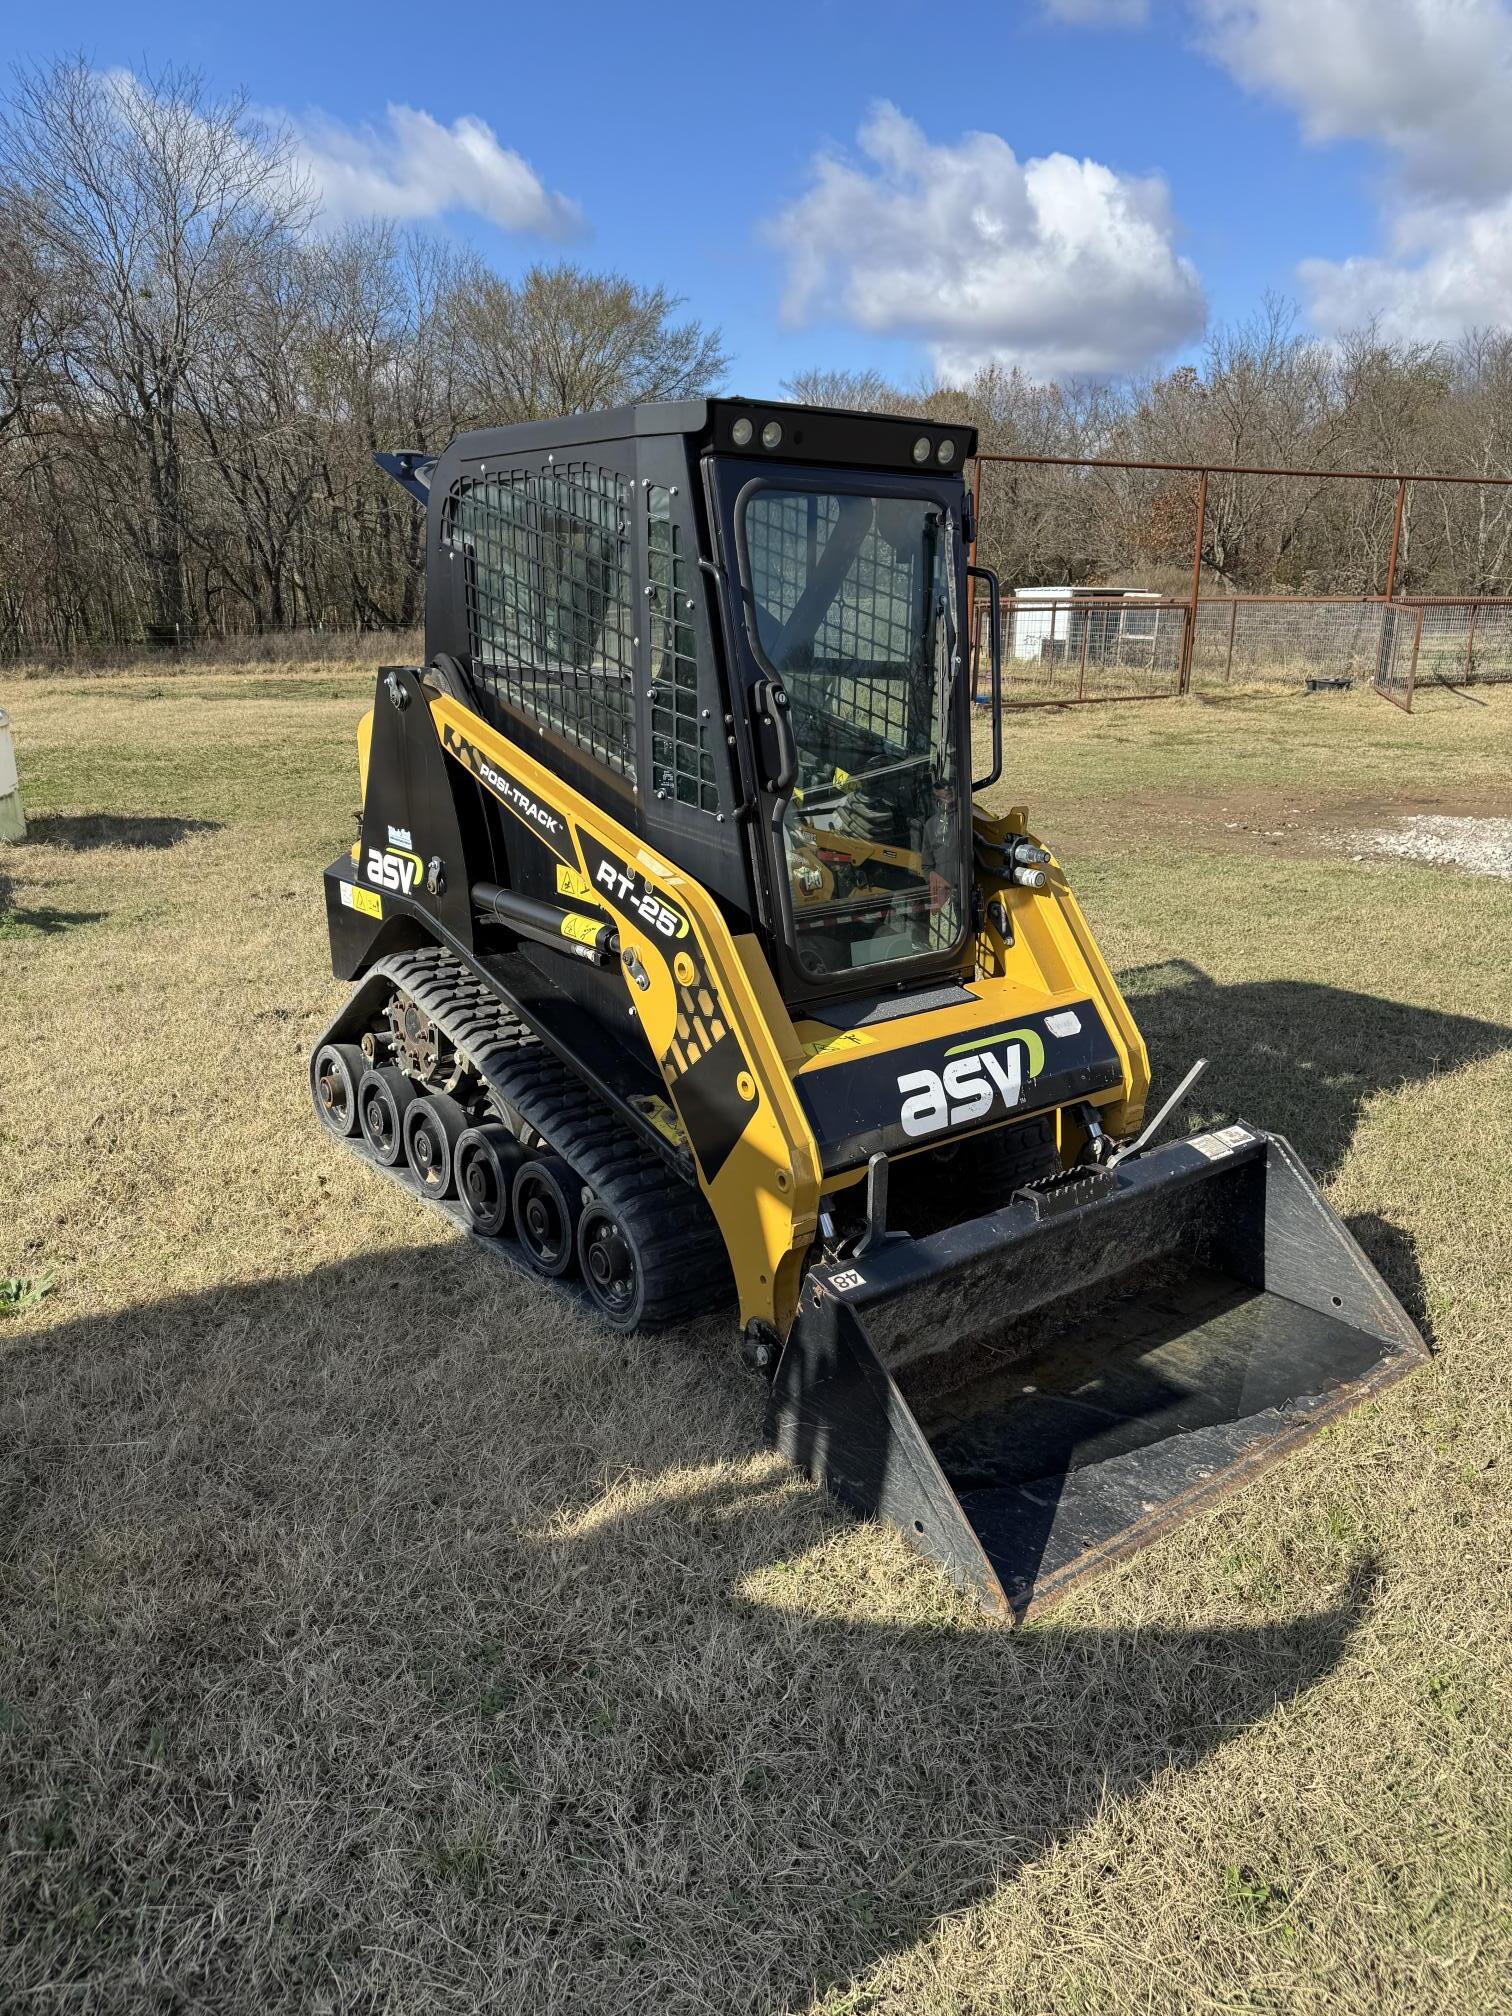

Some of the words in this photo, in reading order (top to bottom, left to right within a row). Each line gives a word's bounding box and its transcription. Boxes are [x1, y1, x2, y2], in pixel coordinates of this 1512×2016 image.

[480, 763, 558, 834] POSI-TRACK
[596, 860, 678, 937] RT-25
[897, 1043, 1022, 1137] asv
[833, 1273, 859, 1289] 48
